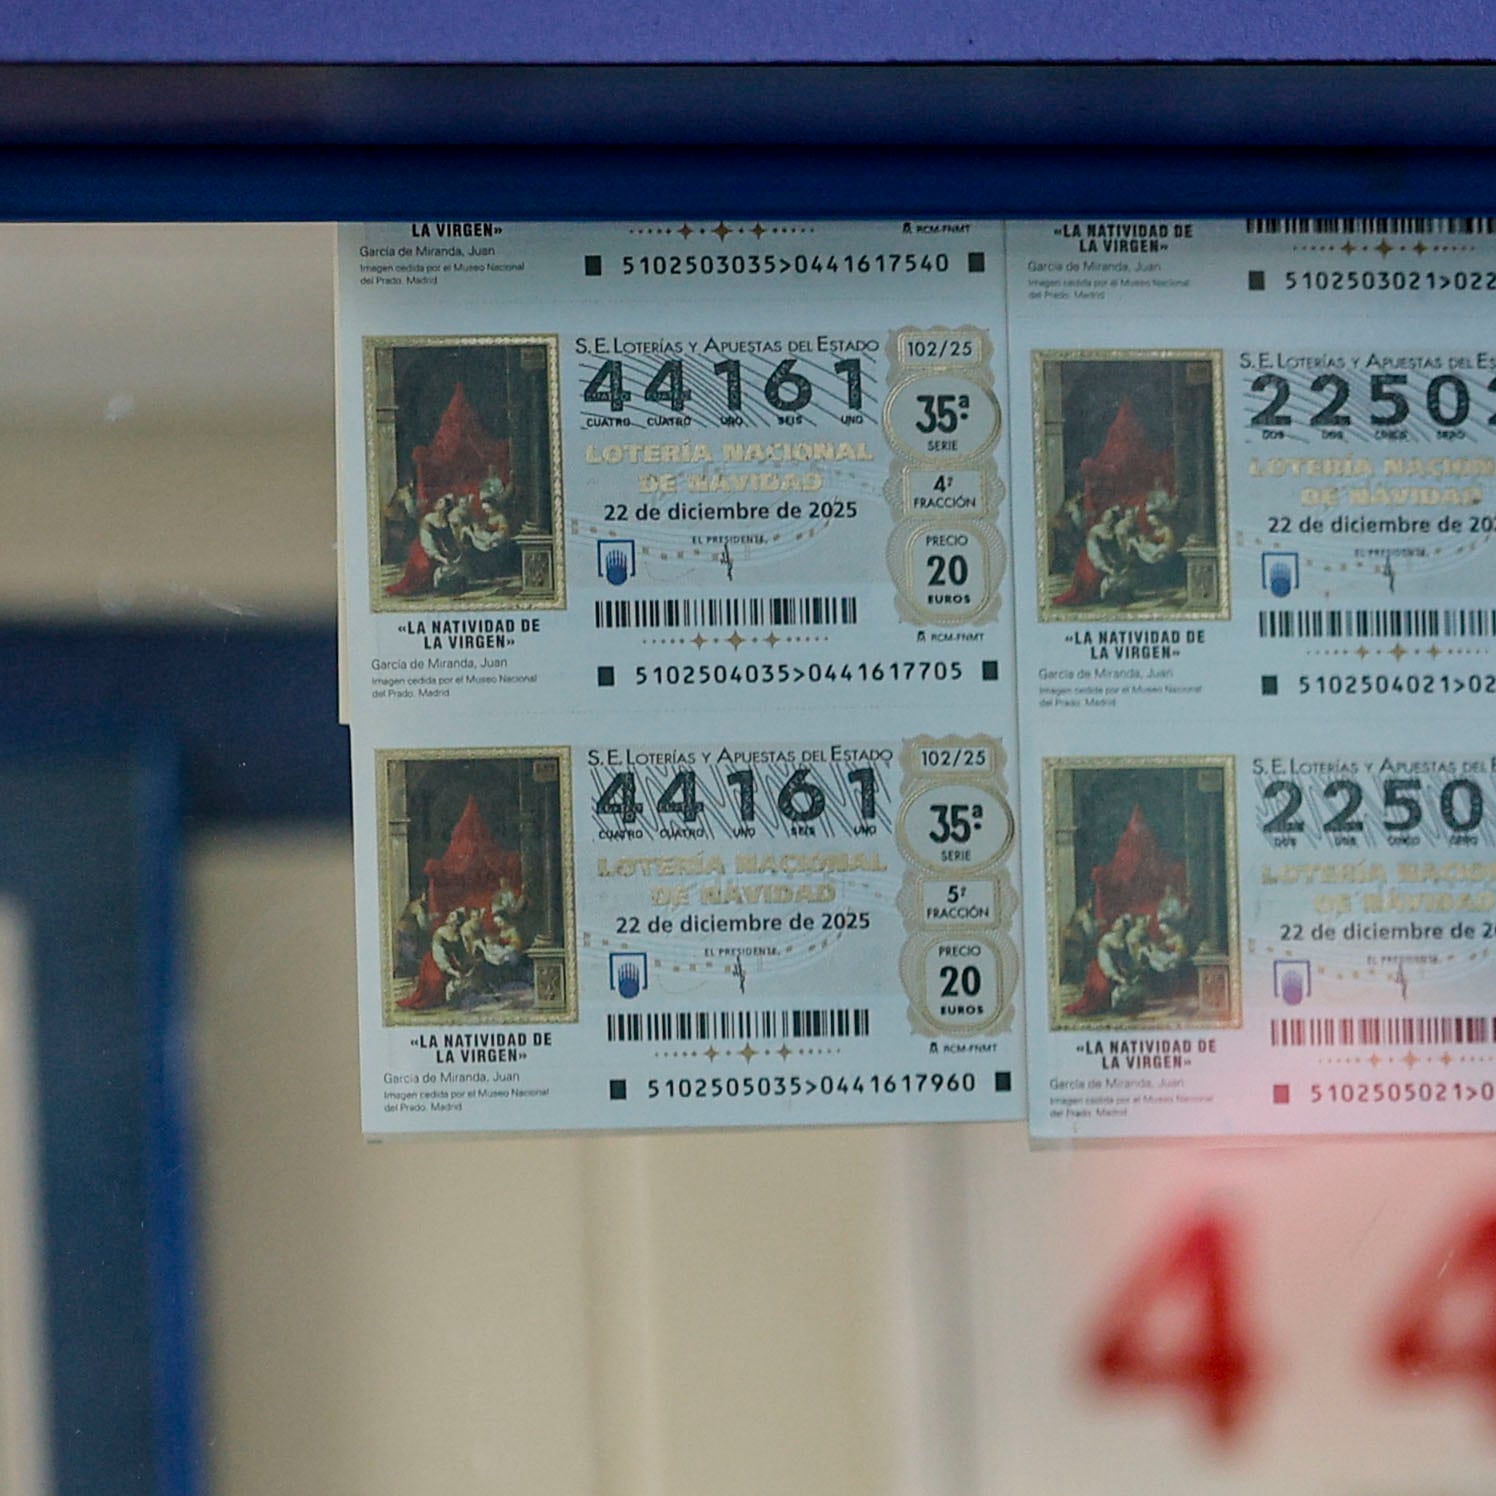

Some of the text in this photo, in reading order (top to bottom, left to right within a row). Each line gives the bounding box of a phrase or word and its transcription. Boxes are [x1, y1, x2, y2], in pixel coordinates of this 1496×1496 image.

[412, 223, 503, 237] LA VIRGEN»
[1087, 224, 1168, 238] NATIVIDAD
[1174, 224, 1193, 237] DE
[398, 247, 412, 257] de
[468, 245, 495, 257] Juan
[1079, 240, 1097, 252] LA
[623, 253, 948, 276] 5102503035>0441617540
[908, 340, 972, 358] 102/25
[583, 358, 862, 412] 44161
[585, 439, 874, 464] LOTERÍA NACIONAL
[928, 441, 958, 451] SERIE
[1249, 453, 1374, 478] LOTERÍA
[639, 472, 824, 494] DE NAVIDAD
[914, 495, 977, 508] FRACCIÓN
[1302, 487, 1484, 508] DE NAVIDAD
[603, 501, 857, 521] 22 de diciembre de 2025
[1267, 517, 1291, 534] 22
[1299, 516, 1324, 534] de
[1330, 516, 1431, 535] diciembre
[1437, 517, 1462, 534] de
[926, 535, 968, 546] PRECIO
[927, 554, 968, 587] 20
[928, 594, 970, 604] EUROS
[432, 619, 515, 634] NATIVIDAD
[521, 618, 540, 632] DE
[424, 636, 442, 649] LA
[1099, 630, 1180, 644] NATIVIDAD
[1186, 629, 1205, 643] DE
[1091, 646, 1109, 659] LA
[371, 658, 407, 671] García
[410, 659, 424, 669] de
[480, 657, 507, 669] Juan
[372, 674, 537, 687] Imagen cedida por el Museo Nacional
[636, 662, 962, 685] 5102504035>0441617705
[921, 749, 985, 768] 102/25
[596, 769, 875, 823] 44161
[598, 851, 887, 876] LOTERÍA NACIONAL
[941, 851, 971, 861] SERIE
[652, 883, 837, 906] DE NAVIDAD
[927, 905, 990, 918] FRACCIÓN
[615, 912, 870, 933] 22 de diciembre de 2025
[1279, 924, 1304, 941] 22
[1312, 923, 1336, 941] de
[1342, 922, 1444, 941] diciembre
[1450, 921, 1476, 939] de
[939, 946, 981, 957] PRECIO
[940, 965, 981, 998] 20
[941, 1005, 983, 1015] EUROS
[444, 1033, 527, 1048] NATIVIDAD
[533, 1031, 552, 1046] DE
[436, 1050, 454, 1063] LA
[648, 1074, 975, 1097] 5102505035>0441617960
